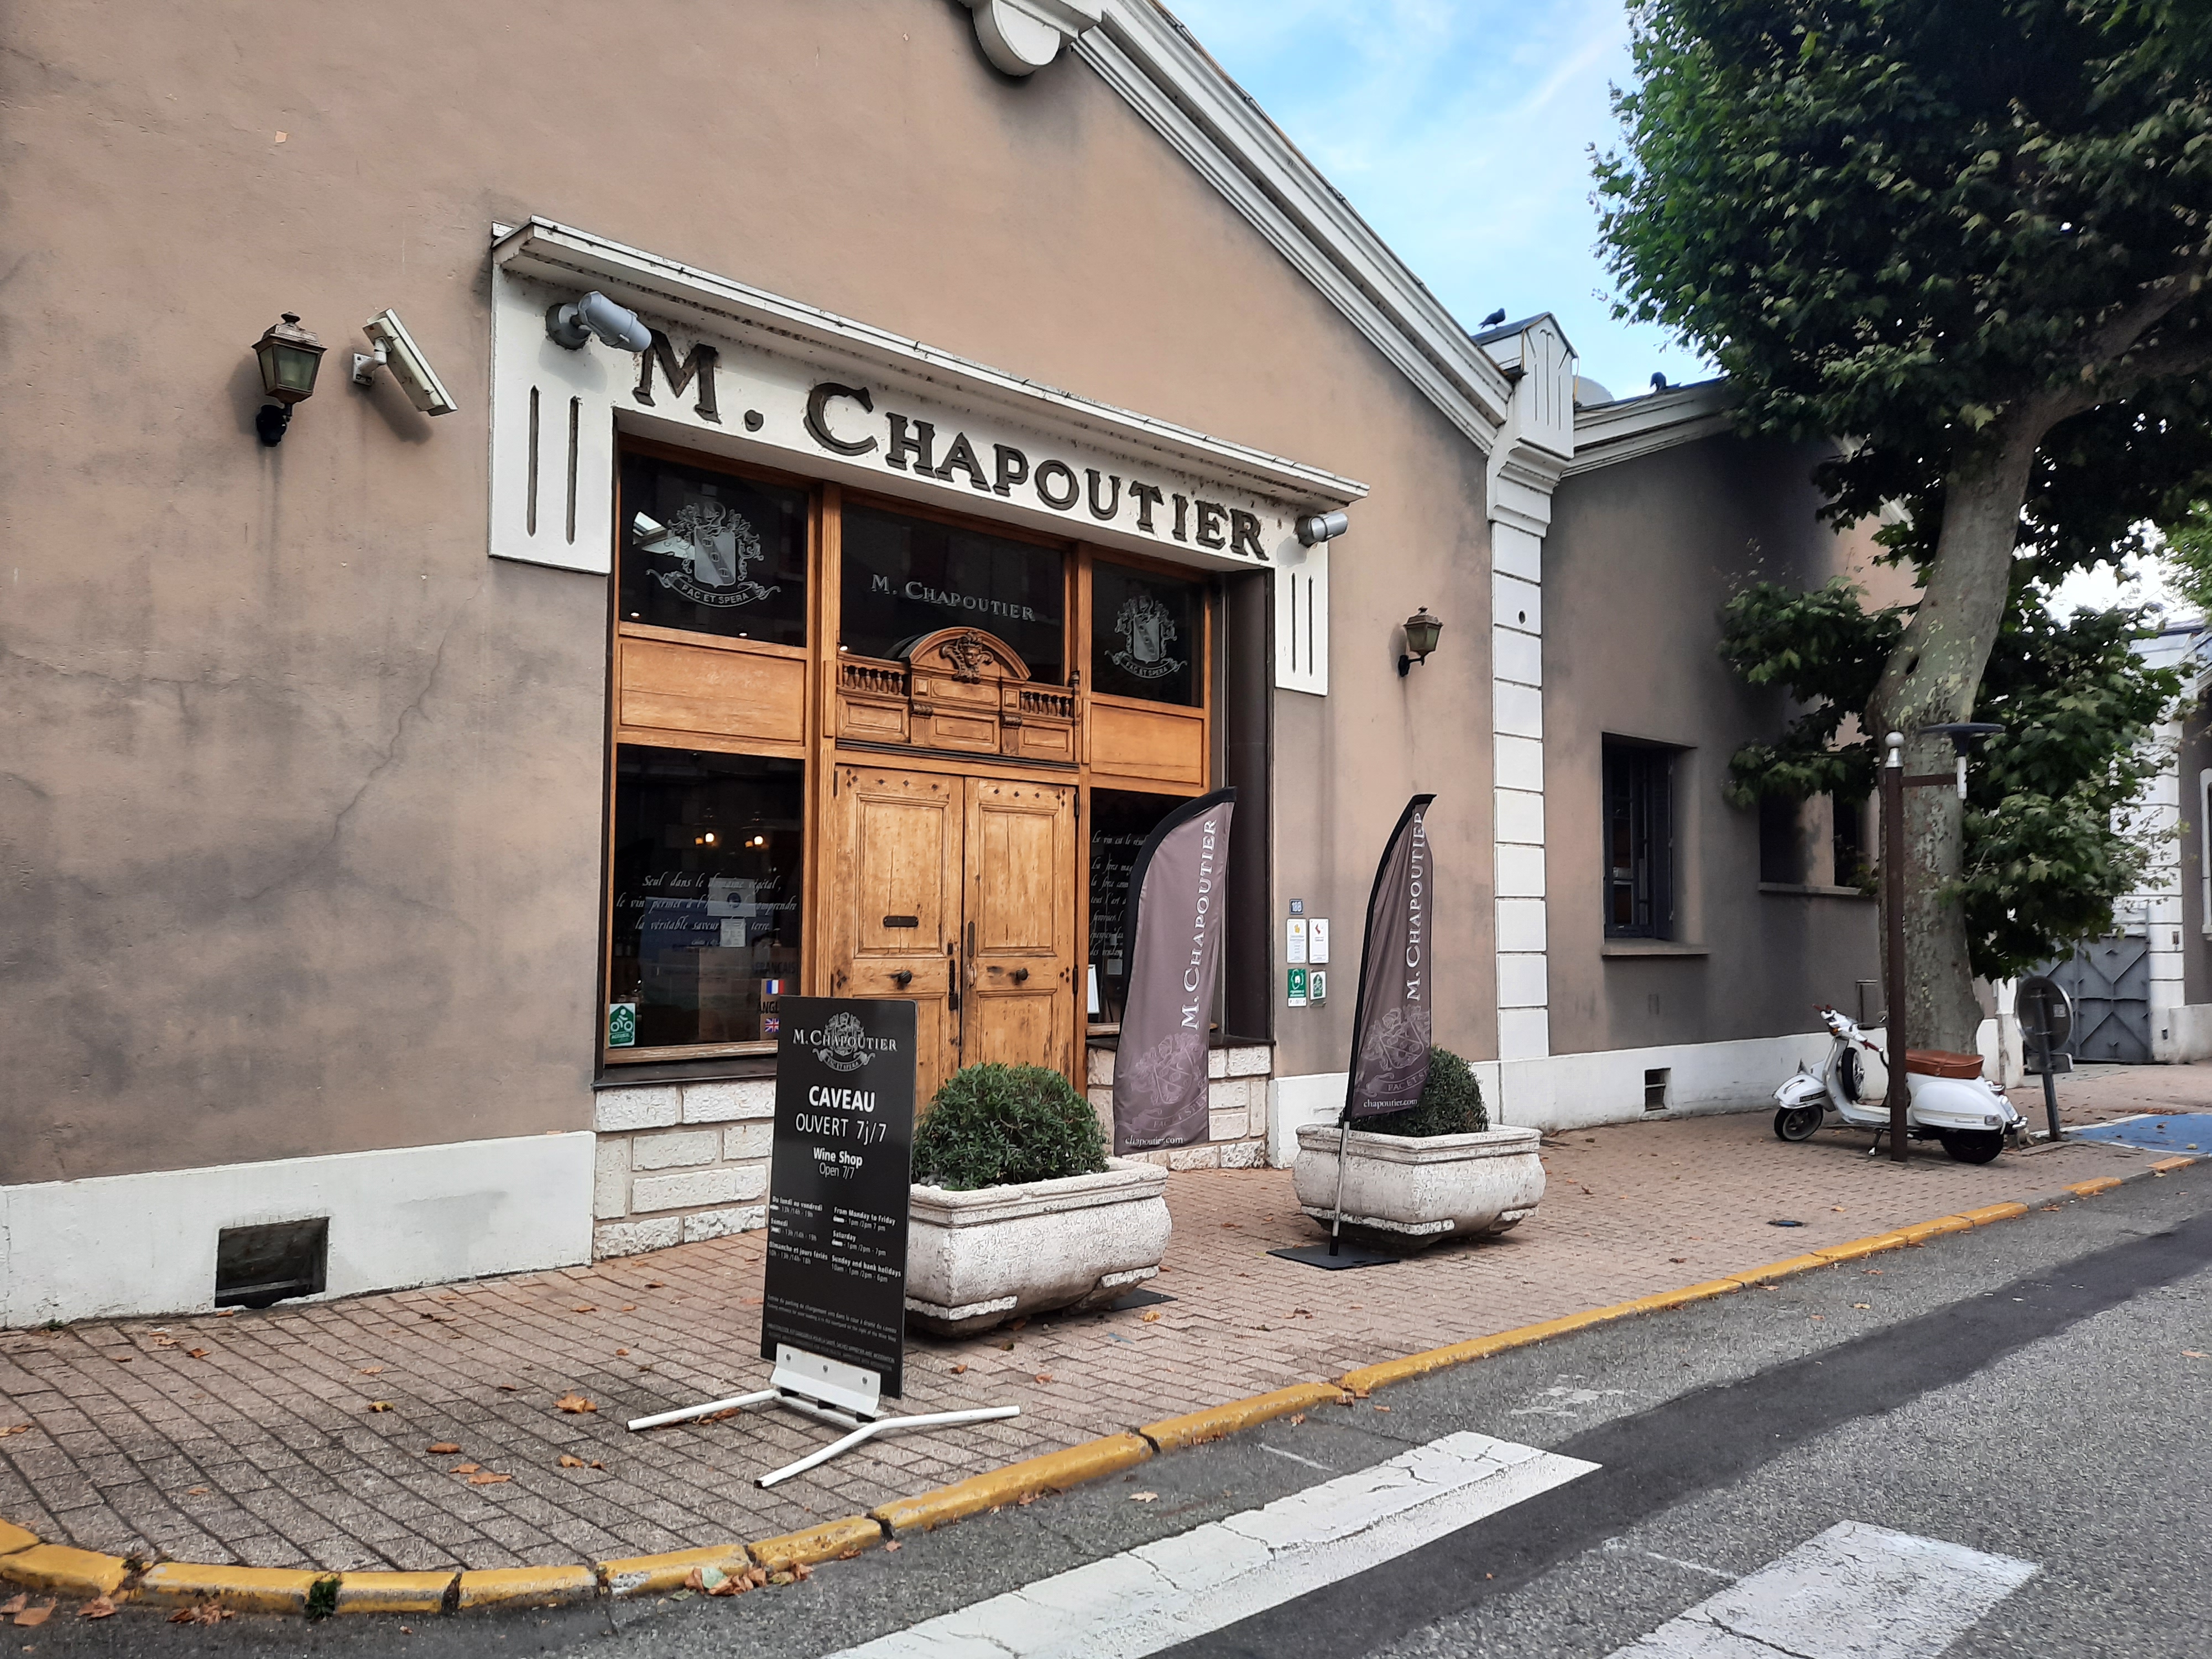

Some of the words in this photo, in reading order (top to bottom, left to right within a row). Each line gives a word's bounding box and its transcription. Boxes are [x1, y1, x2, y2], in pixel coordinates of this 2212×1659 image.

[804, 383, 1269, 561] CHAPOUTIER
[681, 584, 701, 599] FAC
[703, 594, 717, 603] ET
[718, 593, 749, 604] SPERA
[871, 574, 898, 595] M.
[905, 581, 1036, 622] CHAPOUTIER
[695, 873, 705, 888] le
[755, 895, 797, 916] omprendre
[1183, 819, 1217, 993] CHAPOUTIER
[757, 1000, 780, 1014] ANGL
[809, 1086, 875, 1113] CAVEAU
[796, 1113, 849, 1138] OUVERT
[857, 1120, 886, 1146] 7j/7
[813, 1146, 836, 1162] Wine
[838, 1150, 863, 1170] Shop
[819, 1162, 839, 1178] Open
[842, 1165, 855, 1180] 7/7
[834, 1206, 848, 1216] From
[848, 1209, 870, 1222] Monday
[878, 1214, 896, 1227] Friday
[832, 1229, 857, 1243] Saturday
[832, 1254, 851, 1267] Sunday
[878, 1265, 902, 1278] holidays
